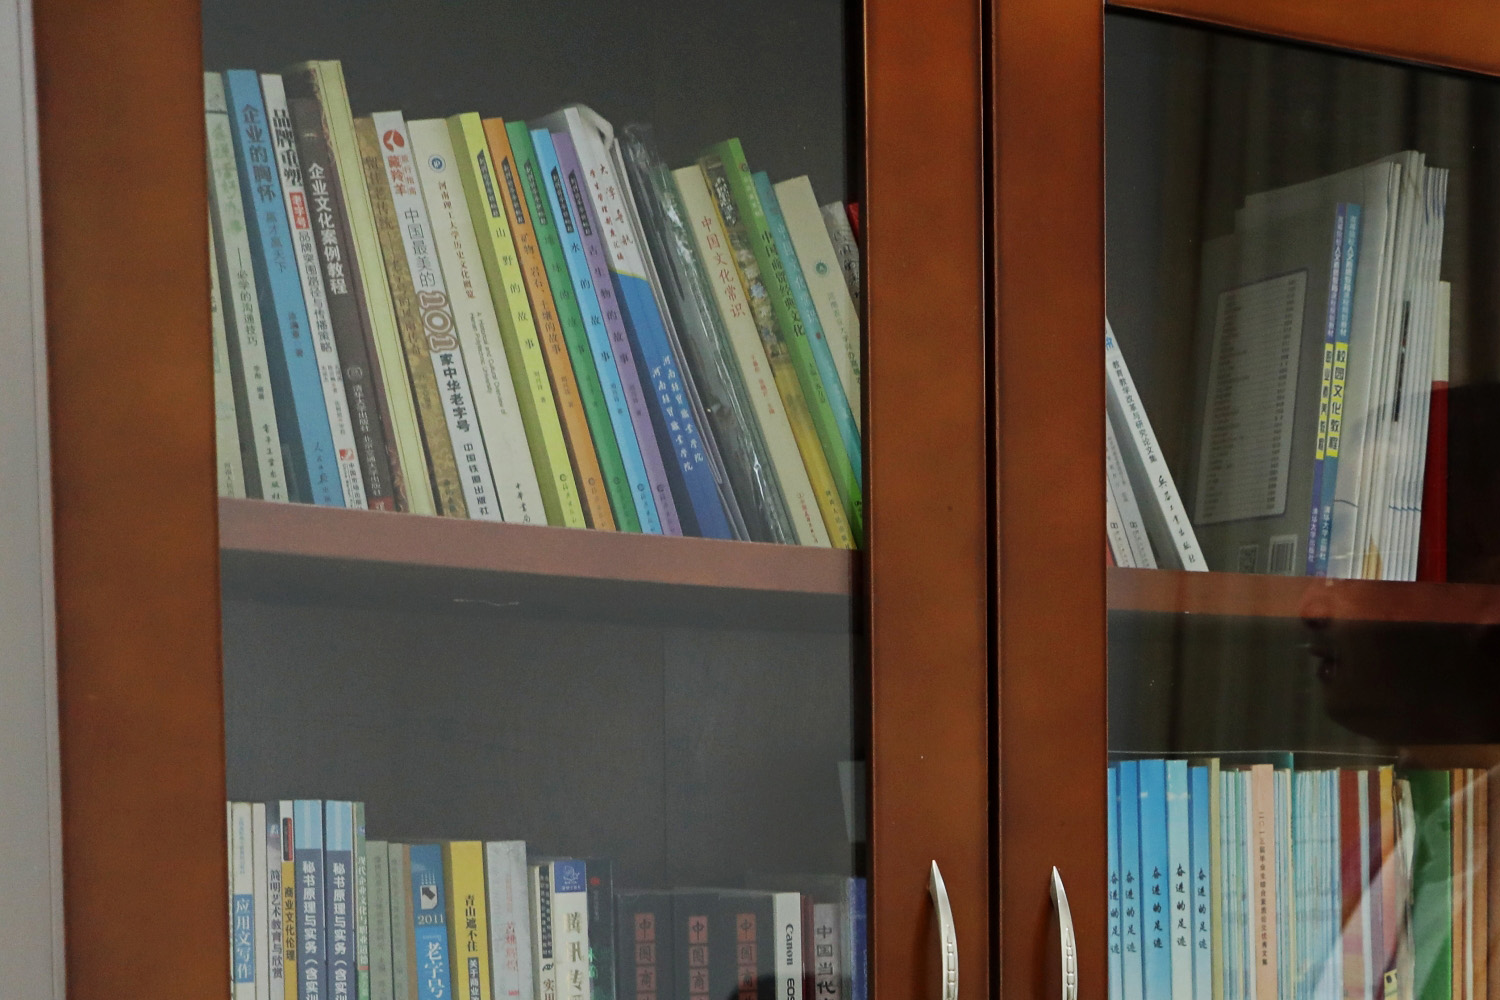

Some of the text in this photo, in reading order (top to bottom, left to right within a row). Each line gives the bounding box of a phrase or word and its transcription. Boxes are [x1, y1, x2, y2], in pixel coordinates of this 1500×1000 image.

[242, 104, 277, 201] 企业的胸怀
[272, 108, 302, 187] 品牌重塑
[308, 162, 349, 295] 企业文化案例教程
[701, 215, 747, 318] 中国文化常识
[495, 226, 536, 350] 山野的故事
[571, 241, 611, 363] 水的故事
[1328, 350, 1346, 450] 校园文化教程
[236, 898, 252, 979] 应用文写作
[269, 869, 283, 979] 简明艺术教育与欣赏
[284, 886, 296, 962] 商业文化伦理
[418, 914, 445, 926] 2011
[785, 924, 794, 965] Canon
[1110, 872, 1120, 954] 奋进的足迹
[1125, 869, 1136, 953] 奋进的足迹
[1152, 866, 1163, 949] 奋进的足迹
[1176, 864, 1187, 947] 奋进的足迹
[1197, 868, 1208, 949] 奋进的足迹
[425, 942, 444, 998] 老字号
